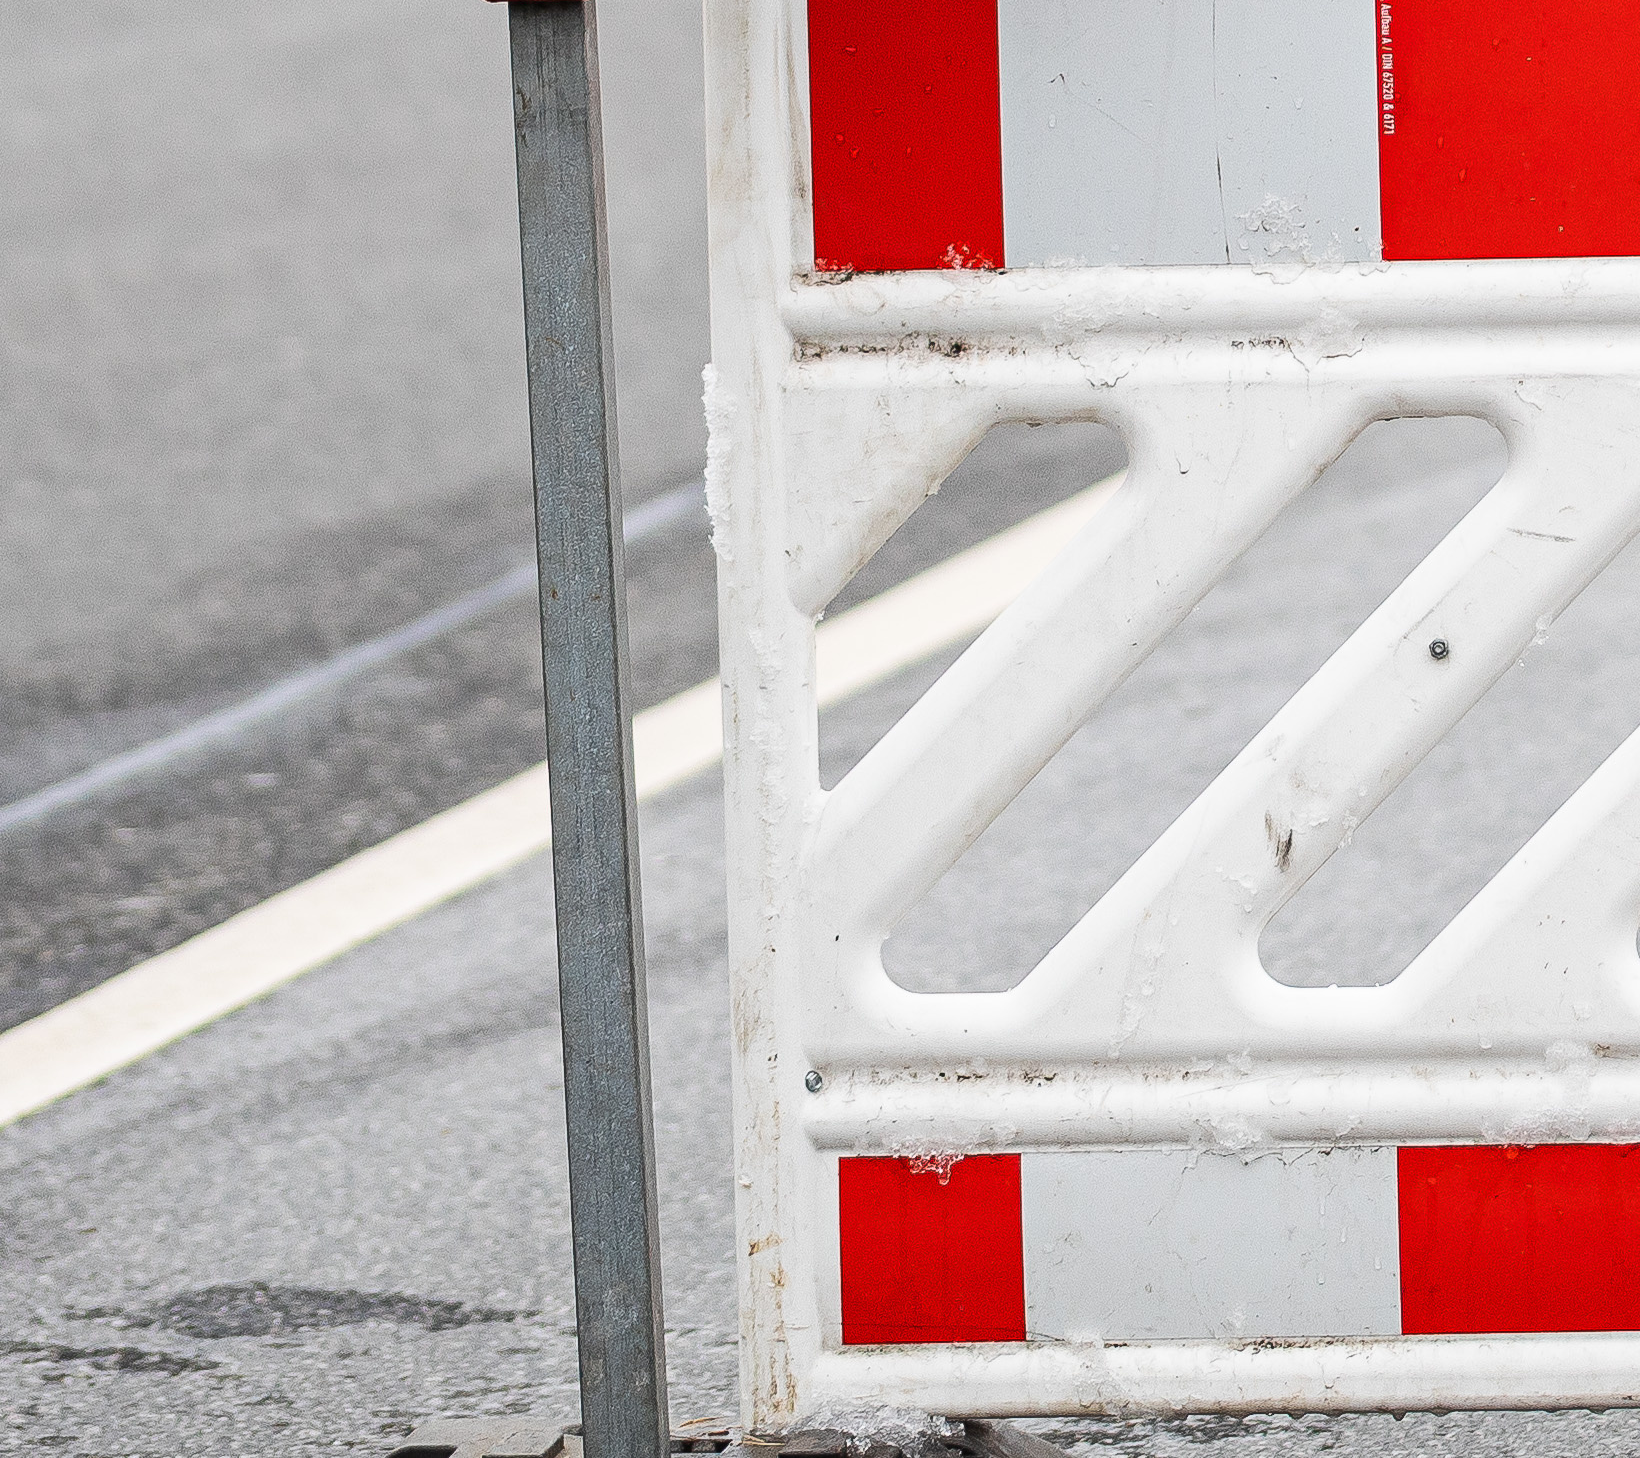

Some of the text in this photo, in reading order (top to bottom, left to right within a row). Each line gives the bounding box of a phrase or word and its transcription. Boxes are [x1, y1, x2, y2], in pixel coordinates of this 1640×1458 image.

[1380, 3, 1392, 36] Aufbau
[1381, 37, 1393, 45] A
[1381, 53, 1394, 70] DIN
[1382, 71, 1394, 101] 67520
[1382, 102, 1395, 111] &
[1383, 113, 1395, 135] 6171
